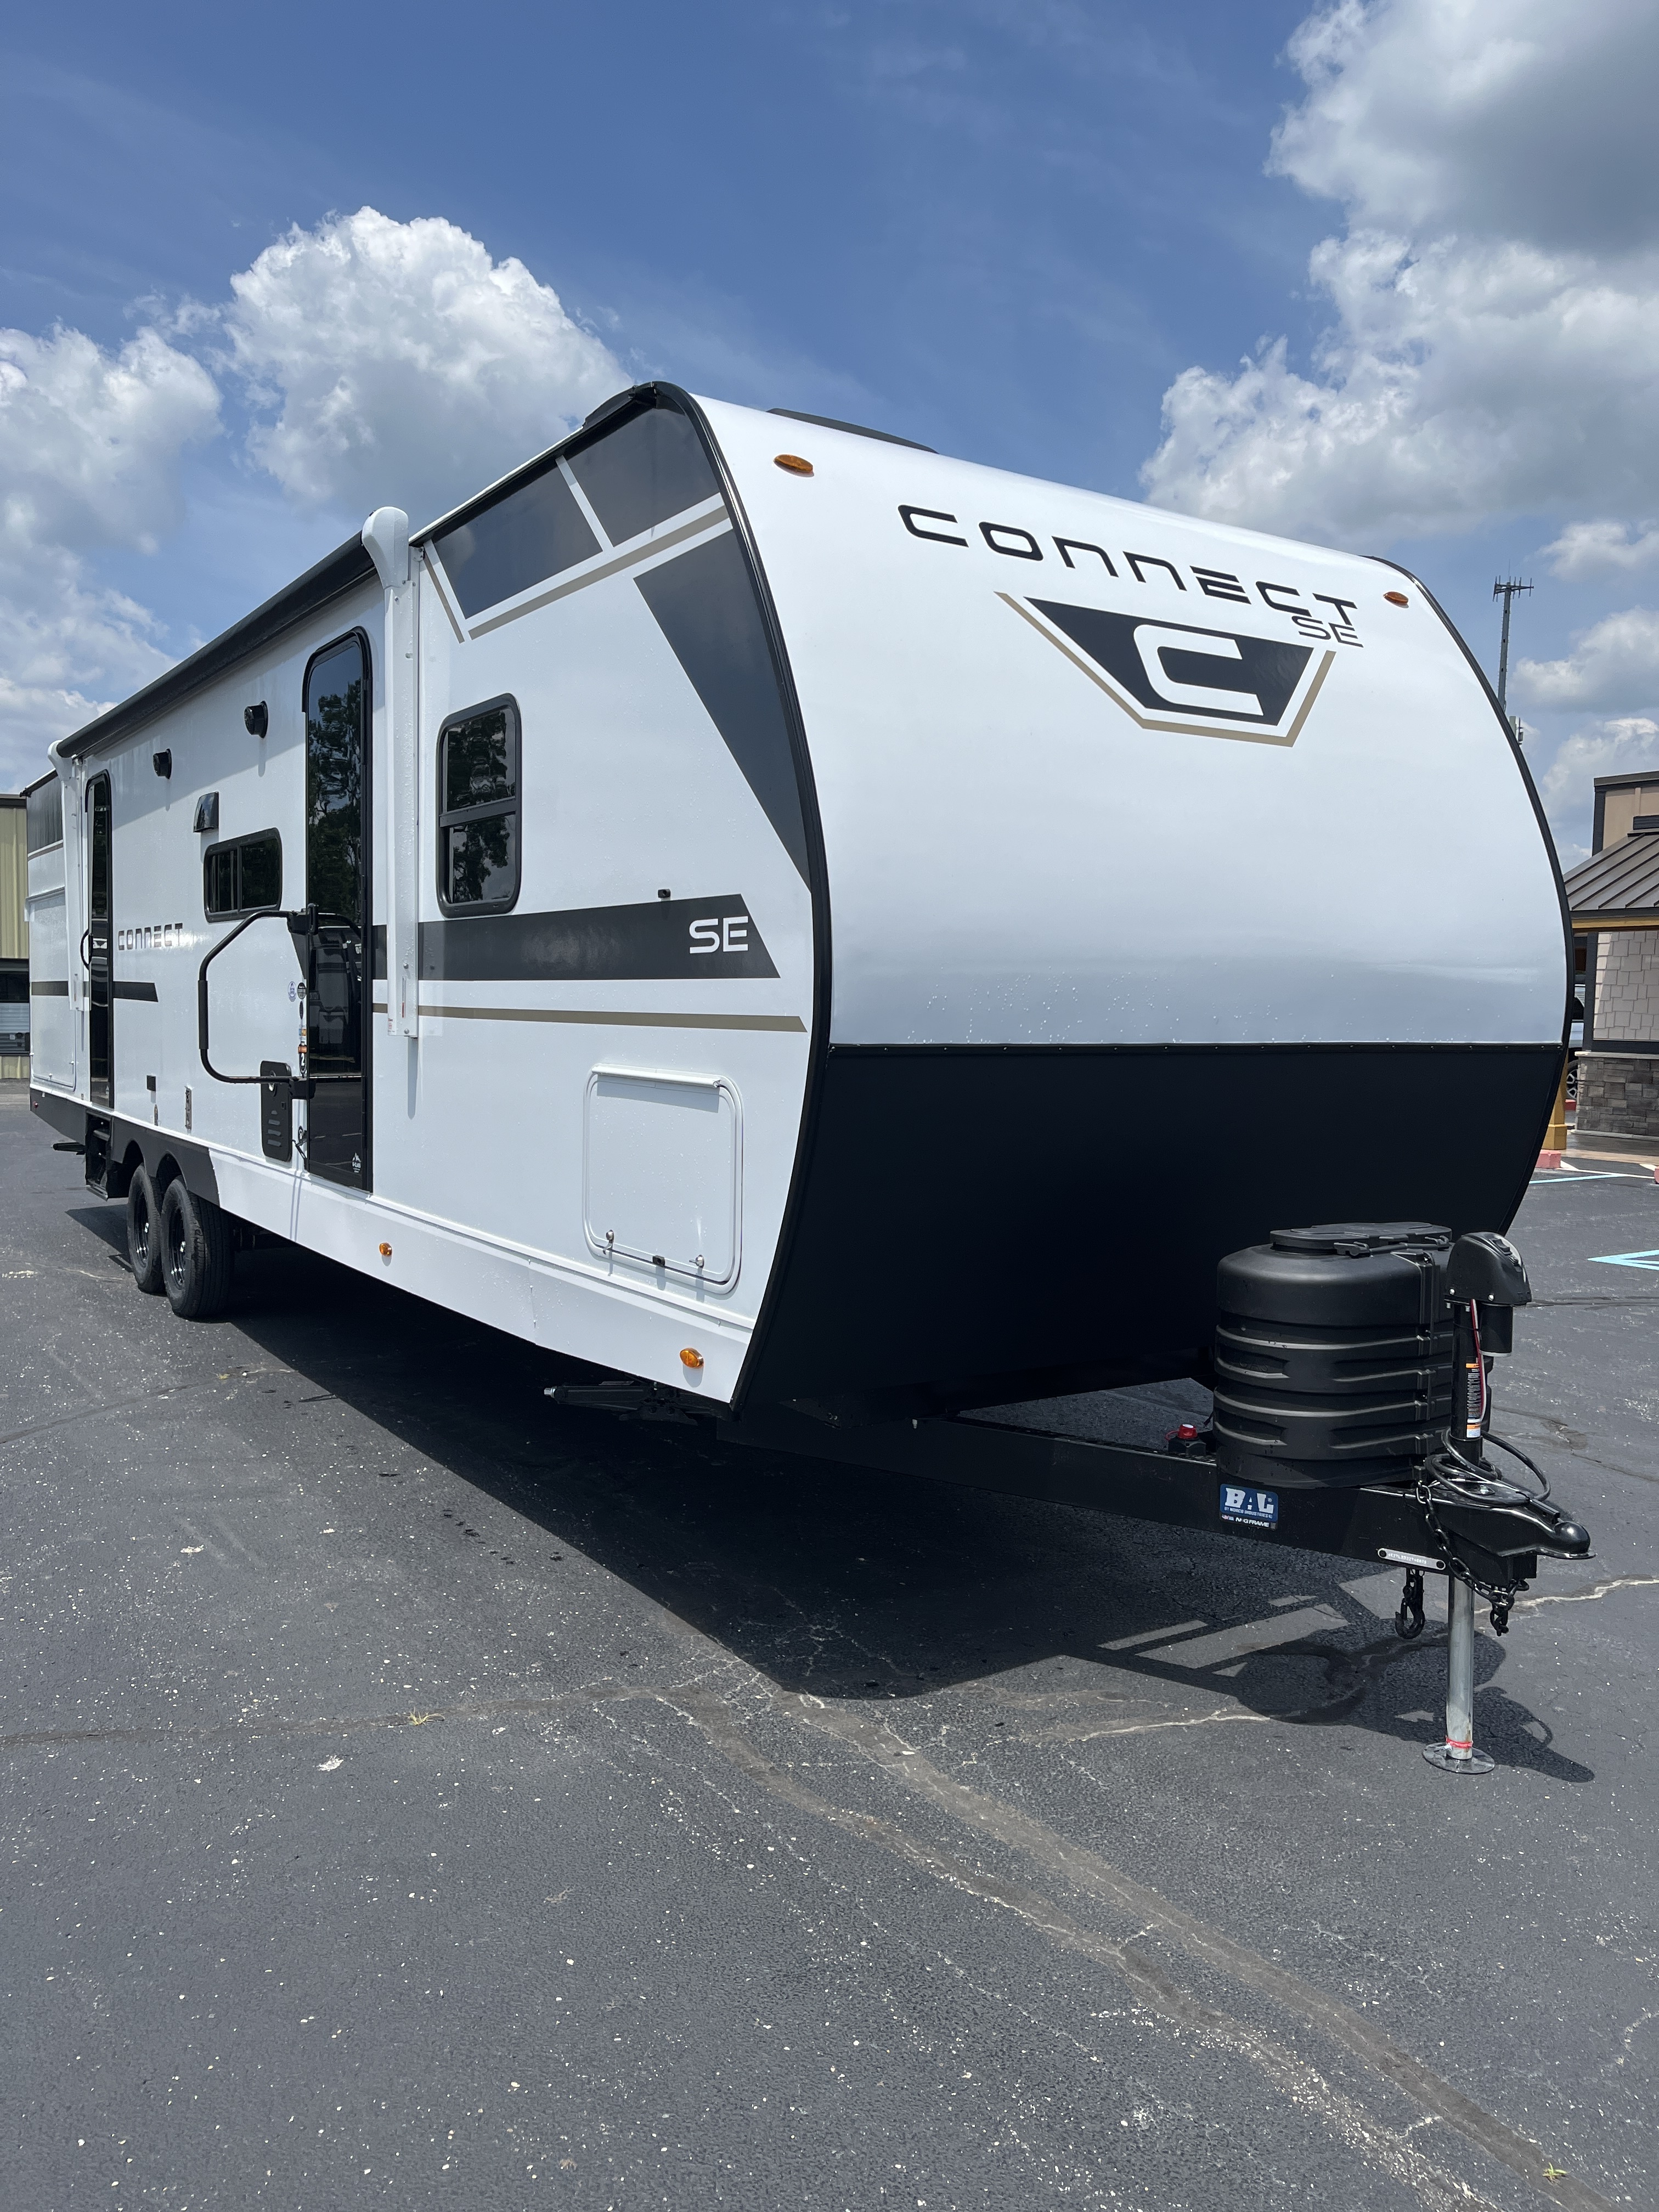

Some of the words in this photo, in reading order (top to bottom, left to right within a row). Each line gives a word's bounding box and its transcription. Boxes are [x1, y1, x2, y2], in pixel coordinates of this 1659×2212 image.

[898, 504, 1358, 625] CONNECT
[1291, 615, 1364, 648] SE
[1133, 624, 1265, 716] C
[118, 922, 183, 951] CONNECT
[689, 916, 748, 954] SE
